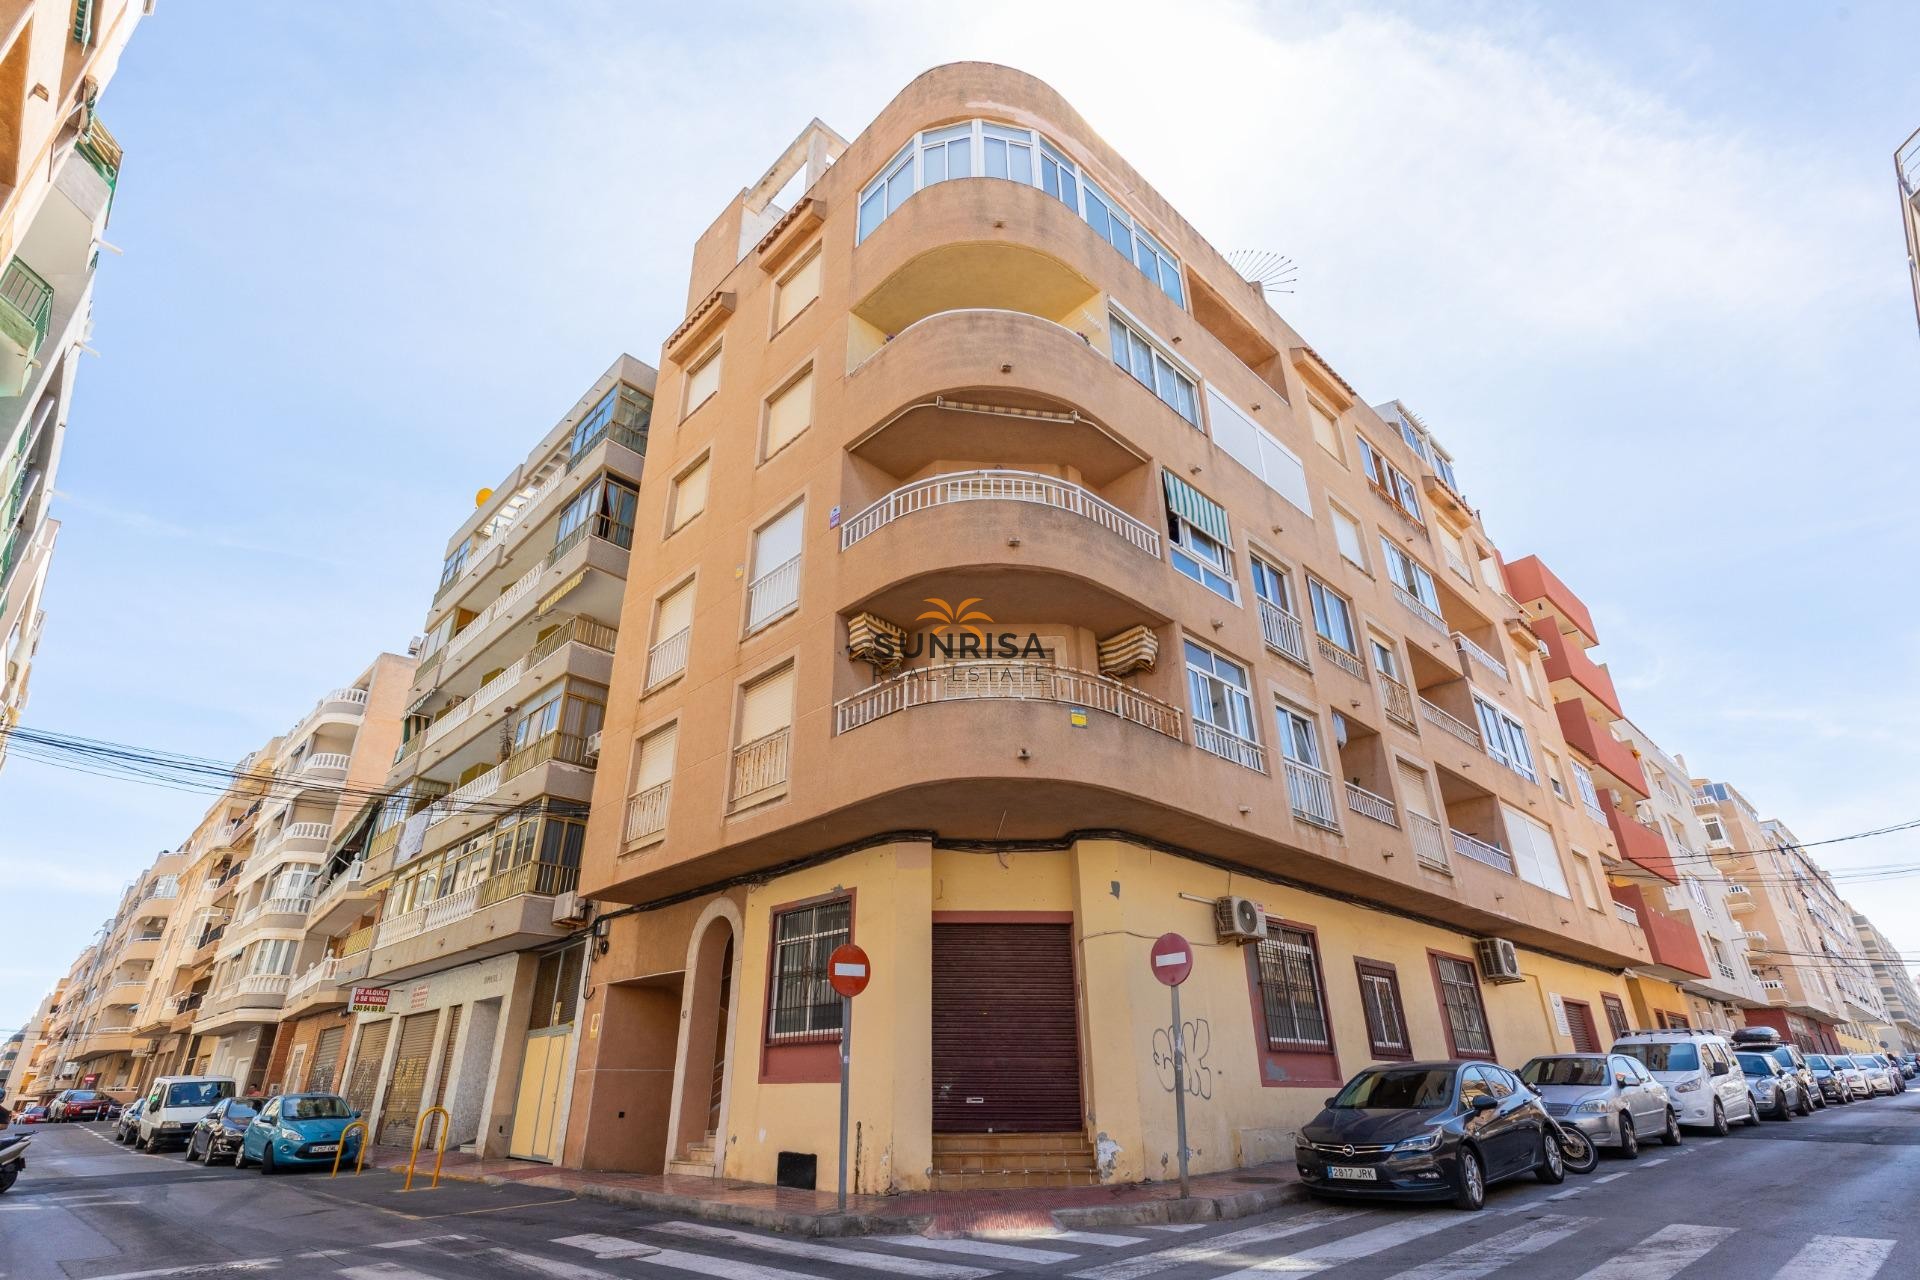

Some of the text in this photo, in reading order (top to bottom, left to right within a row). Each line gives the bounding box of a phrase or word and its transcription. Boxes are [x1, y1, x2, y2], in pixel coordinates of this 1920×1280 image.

[368, 995, 388, 1003] VENDE
[1333, 1168, 1374, 1179] 2817 JRK
